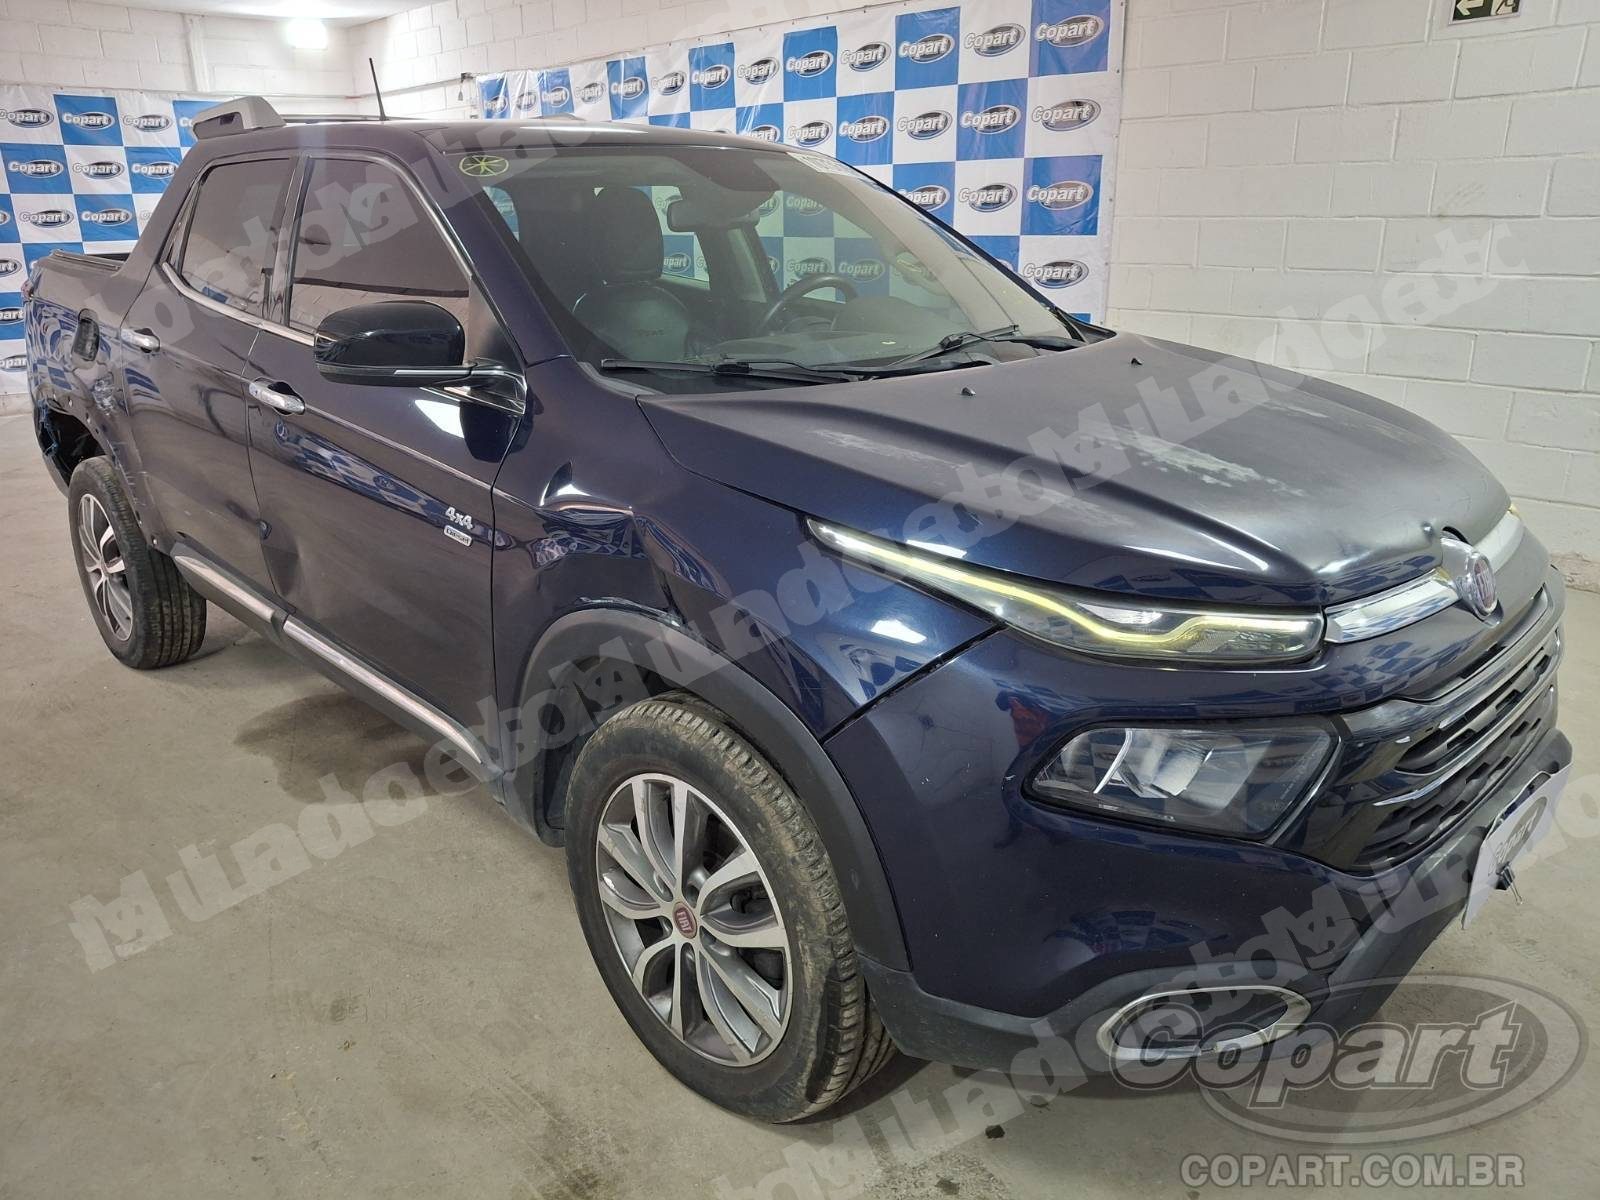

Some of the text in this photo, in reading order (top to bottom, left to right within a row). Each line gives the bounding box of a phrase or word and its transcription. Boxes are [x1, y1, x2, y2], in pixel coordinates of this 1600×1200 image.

[1035, 20, 1097, 42] Copart
[899, 38, 948, 59] Copart
[964, 31, 1017, 50] Copart
[786, 54, 828, 73] Copart
[841, 46, 884, 65] Copart
[691, 68, 726, 85] Copart
[737, 62, 773, 81] Copart
[62, 113, 109, 125] Copart
[123, 115, 167, 127] Copart
[960, 110, 1014, 130] Copart
[1032, 104, 1090, 123] Copart
[787, 125, 827, 140] Copart
[839, 119, 885, 138] Copart
[897, 115, 946, 134] Copart
[8, 162, 59, 174] Copart
[72, 163, 119, 175] Copart
[131, 163, 175, 176] Copart
[959, 187, 1012, 205] Copart
[1026, 185, 1085, 204] Copart
[19, 212, 68, 224] Copart
[81, 210, 127, 223] Copart
[663, 256, 688, 269] opart
[786, 260, 825, 273] Copart
[838, 261, 881, 277] Copart
[1023, 263, 1078, 281] Copart
[445, 506, 473, 530] 4x4
[676, 911, 693, 932] FIAT
